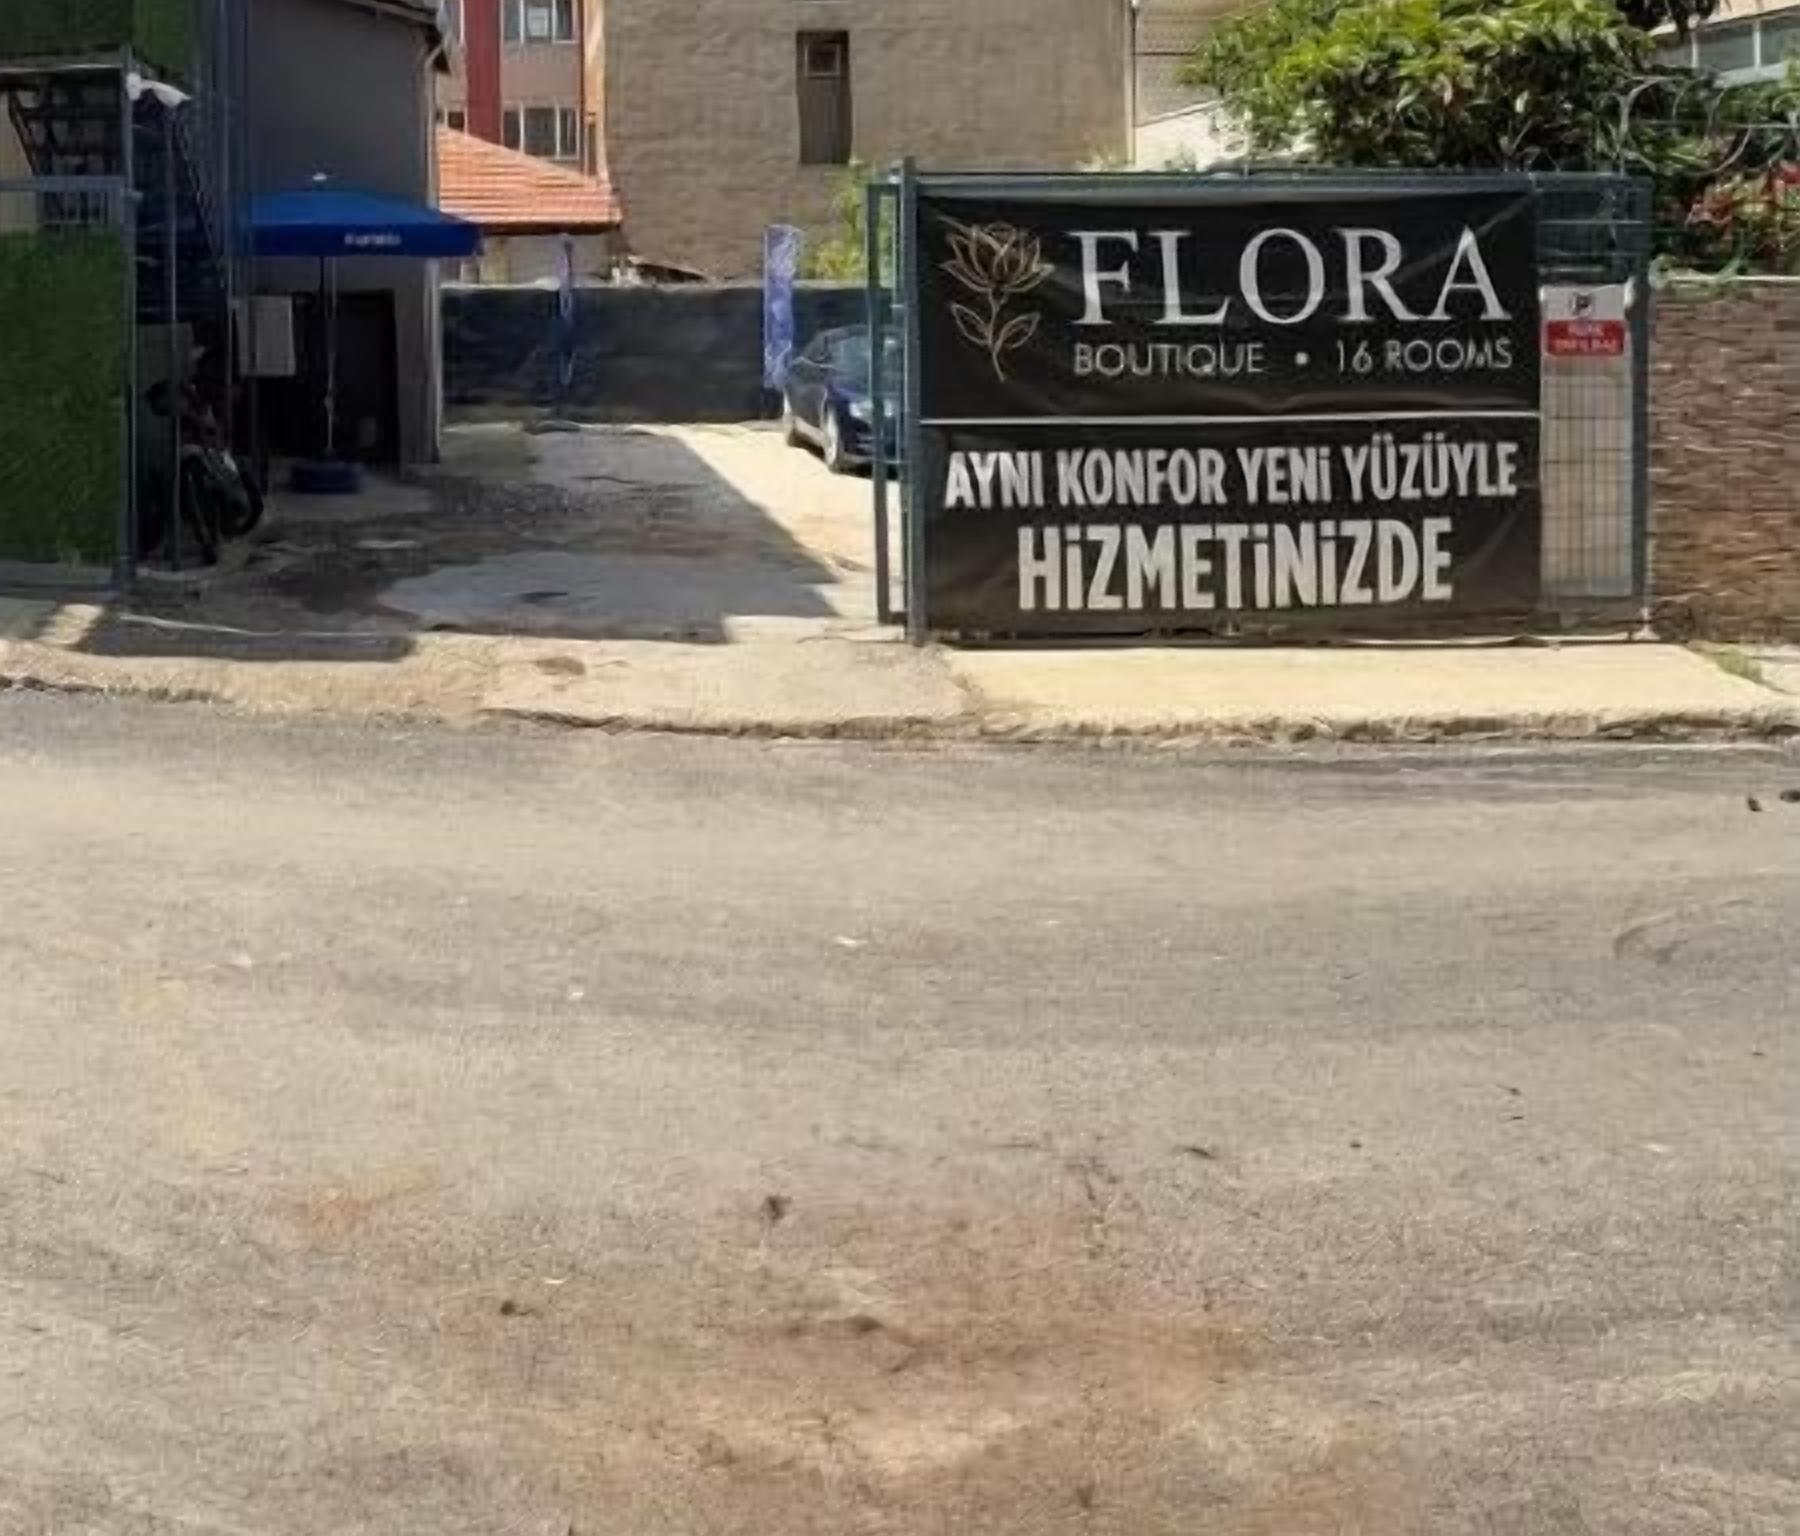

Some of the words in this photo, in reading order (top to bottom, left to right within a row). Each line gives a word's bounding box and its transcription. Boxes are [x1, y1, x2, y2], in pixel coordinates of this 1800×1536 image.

[1066, 226, 1512, 326] FLORA
[1073, 341, 1265, 377] BOUTIQUE
[1336, 340, 1373, 374] 16
[1387, 337, 1514, 373] ROOMS
[944, 450, 1044, 509] AYNI
[1056, 448, 1228, 507] KONFOR
[1342, 432, 1519, 503] YÜZÜYLE
